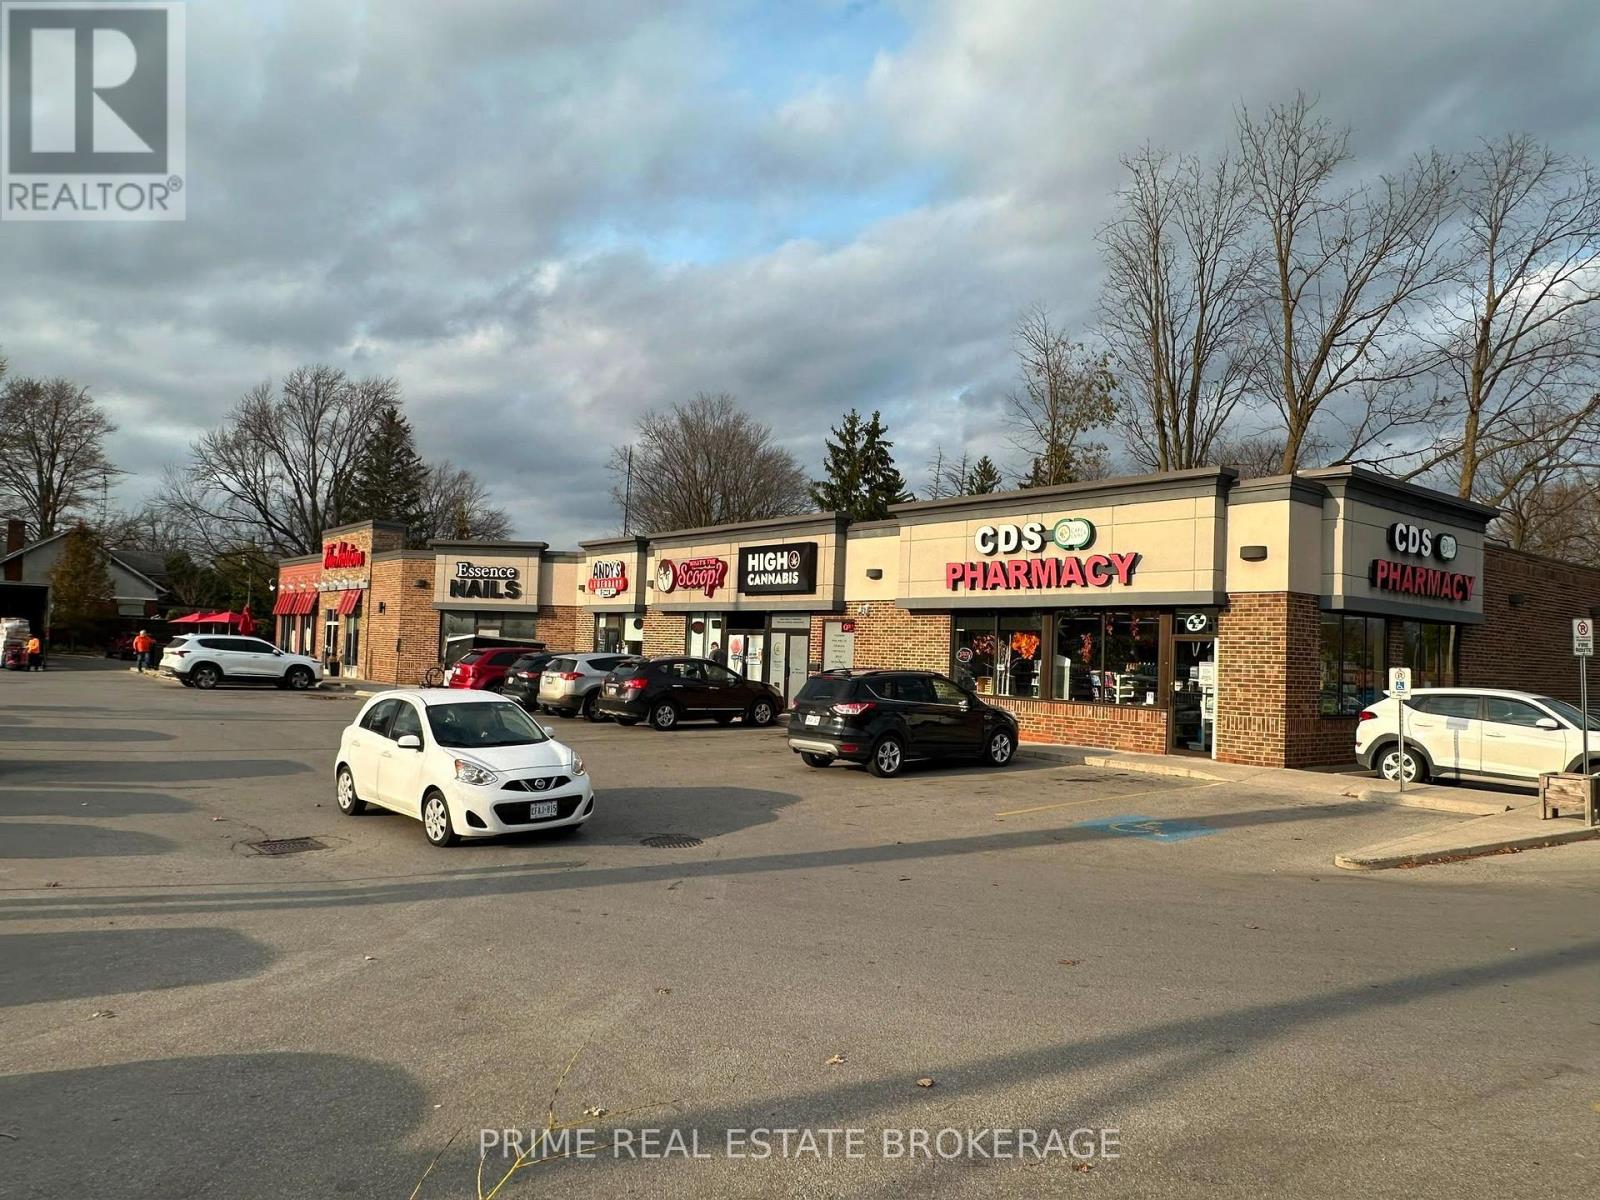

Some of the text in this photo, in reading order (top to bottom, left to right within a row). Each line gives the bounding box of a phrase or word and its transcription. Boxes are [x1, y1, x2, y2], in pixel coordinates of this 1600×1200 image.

[974, 522, 1043, 554] CDS
[1394, 523, 1432, 557] CDS
[456, 561, 515, 578] Essence
[678, 561, 722, 595] Scoop?
[748, 552, 788, 572] HIGH
[946, 552, 1137, 590] PHARMACY
[450, 579, 523, 598] NAILS
[747, 571, 799, 586] CANNABIS
[1377, 559, 1476, 600] PHARMACY
